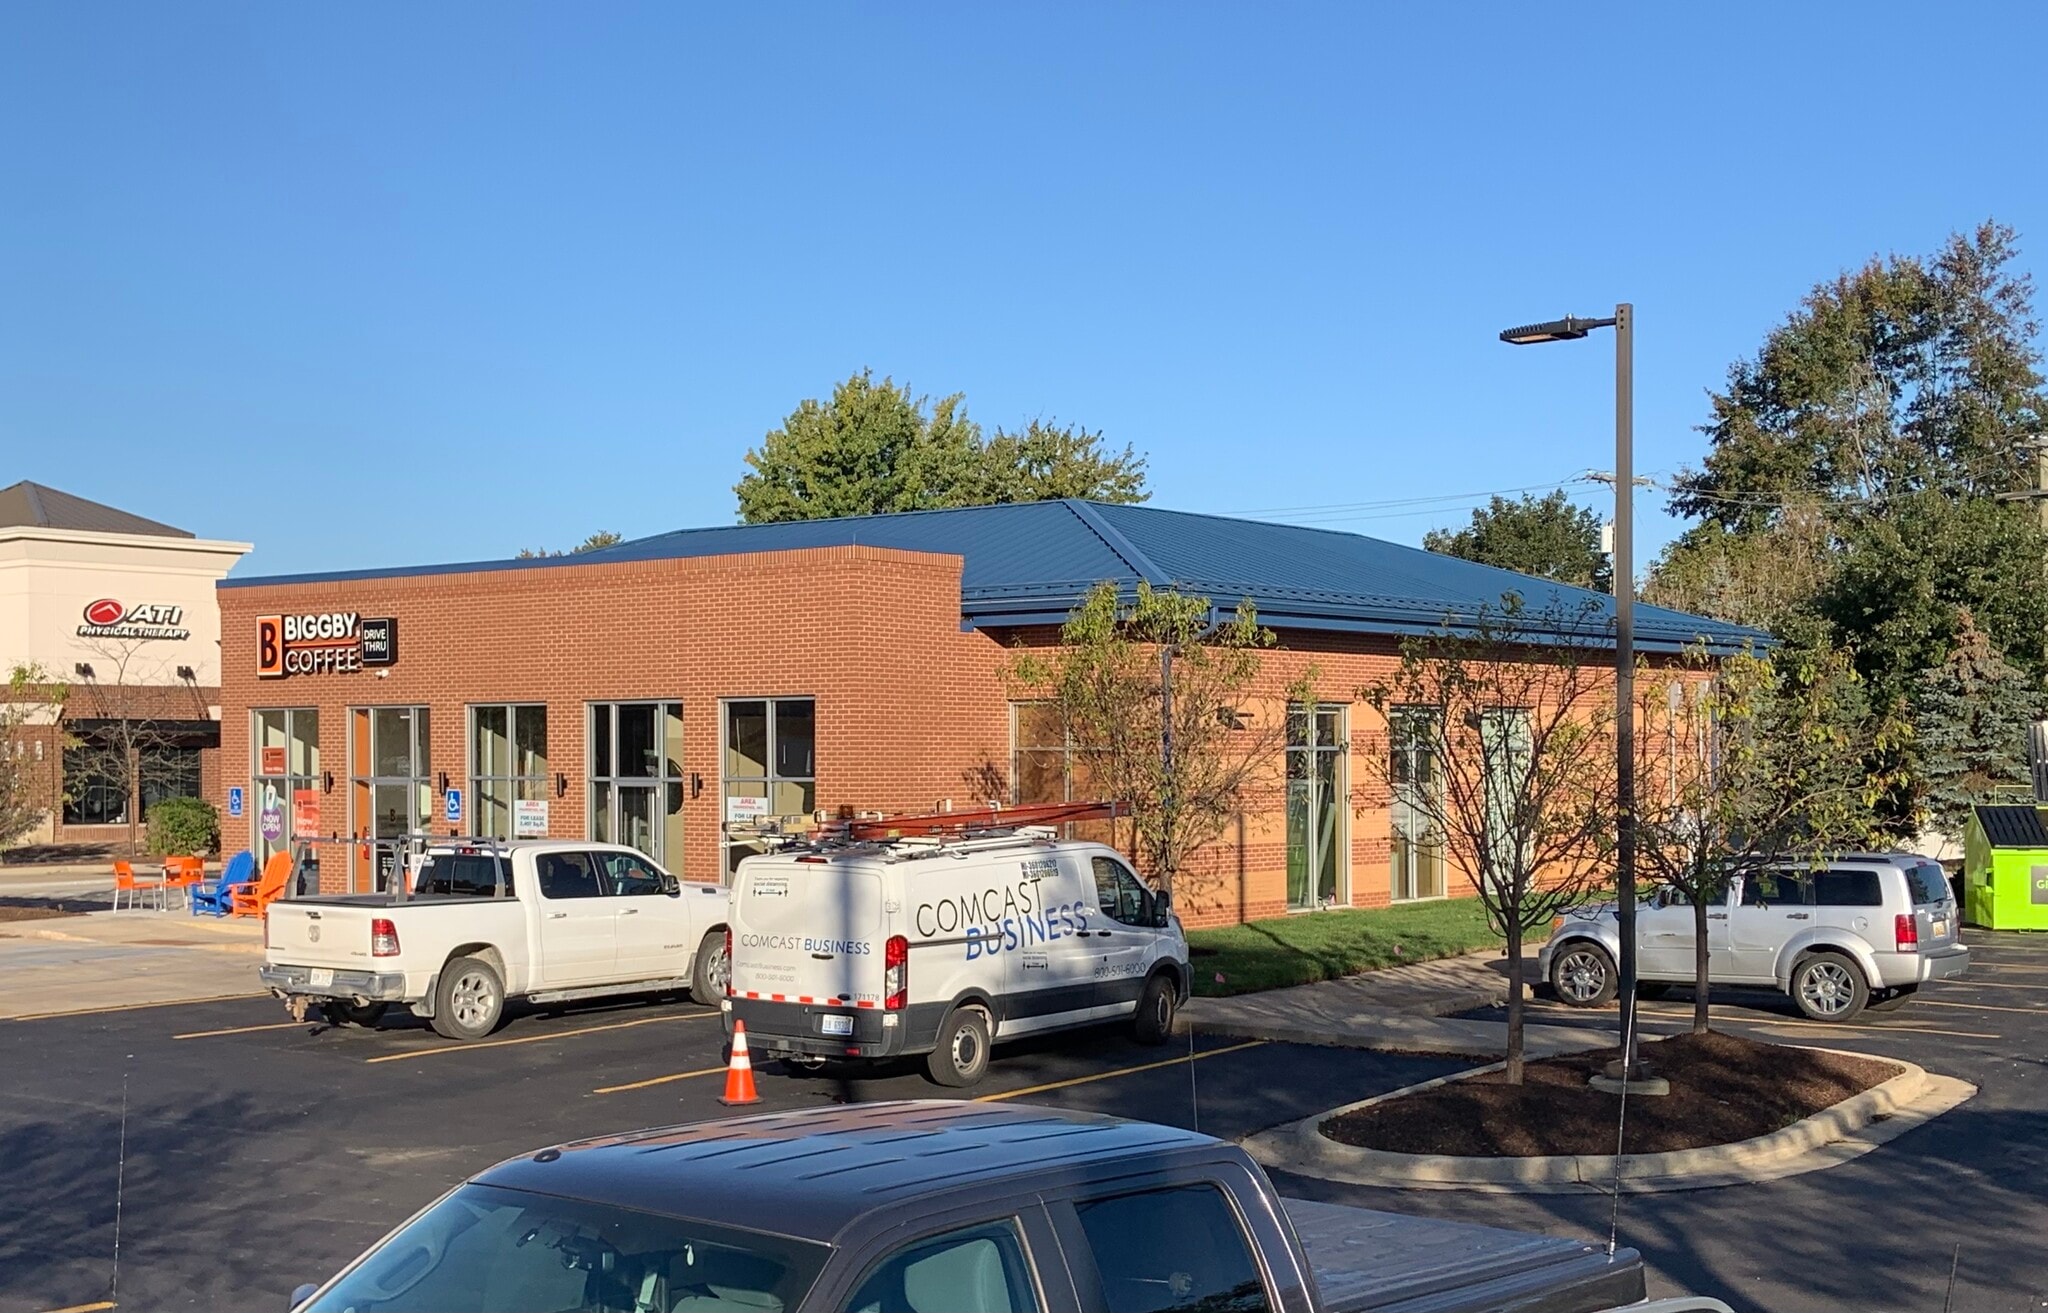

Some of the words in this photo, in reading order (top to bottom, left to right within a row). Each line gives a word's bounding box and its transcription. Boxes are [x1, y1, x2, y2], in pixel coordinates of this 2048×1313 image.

[127, 604, 182, 625] ATI
[78, 625, 138, 638] PHYSICAL
[137, 627, 189, 640] THERAPY
[284, 612, 357, 641] BIGGBY
[364, 628, 386, 640] DRIVE
[260, 622, 278, 669] B
[364, 641, 387, 652] THRU
[285, 648, 358, 672] COFFEE
[262, 823, 281, 832] OPEN!
[263, 815, 280, 823] NOW
[917, 878, 1041, 937] COMCAST
[966, 901, 1088, 961] BUSINESS
[741, 934, 802, 950] COMCAST
[804, 938, 871, 956] BUSINESS
[1094, 961, 1147, 979] 800-501-6000
[854, 992, 880, 1001] 171178
